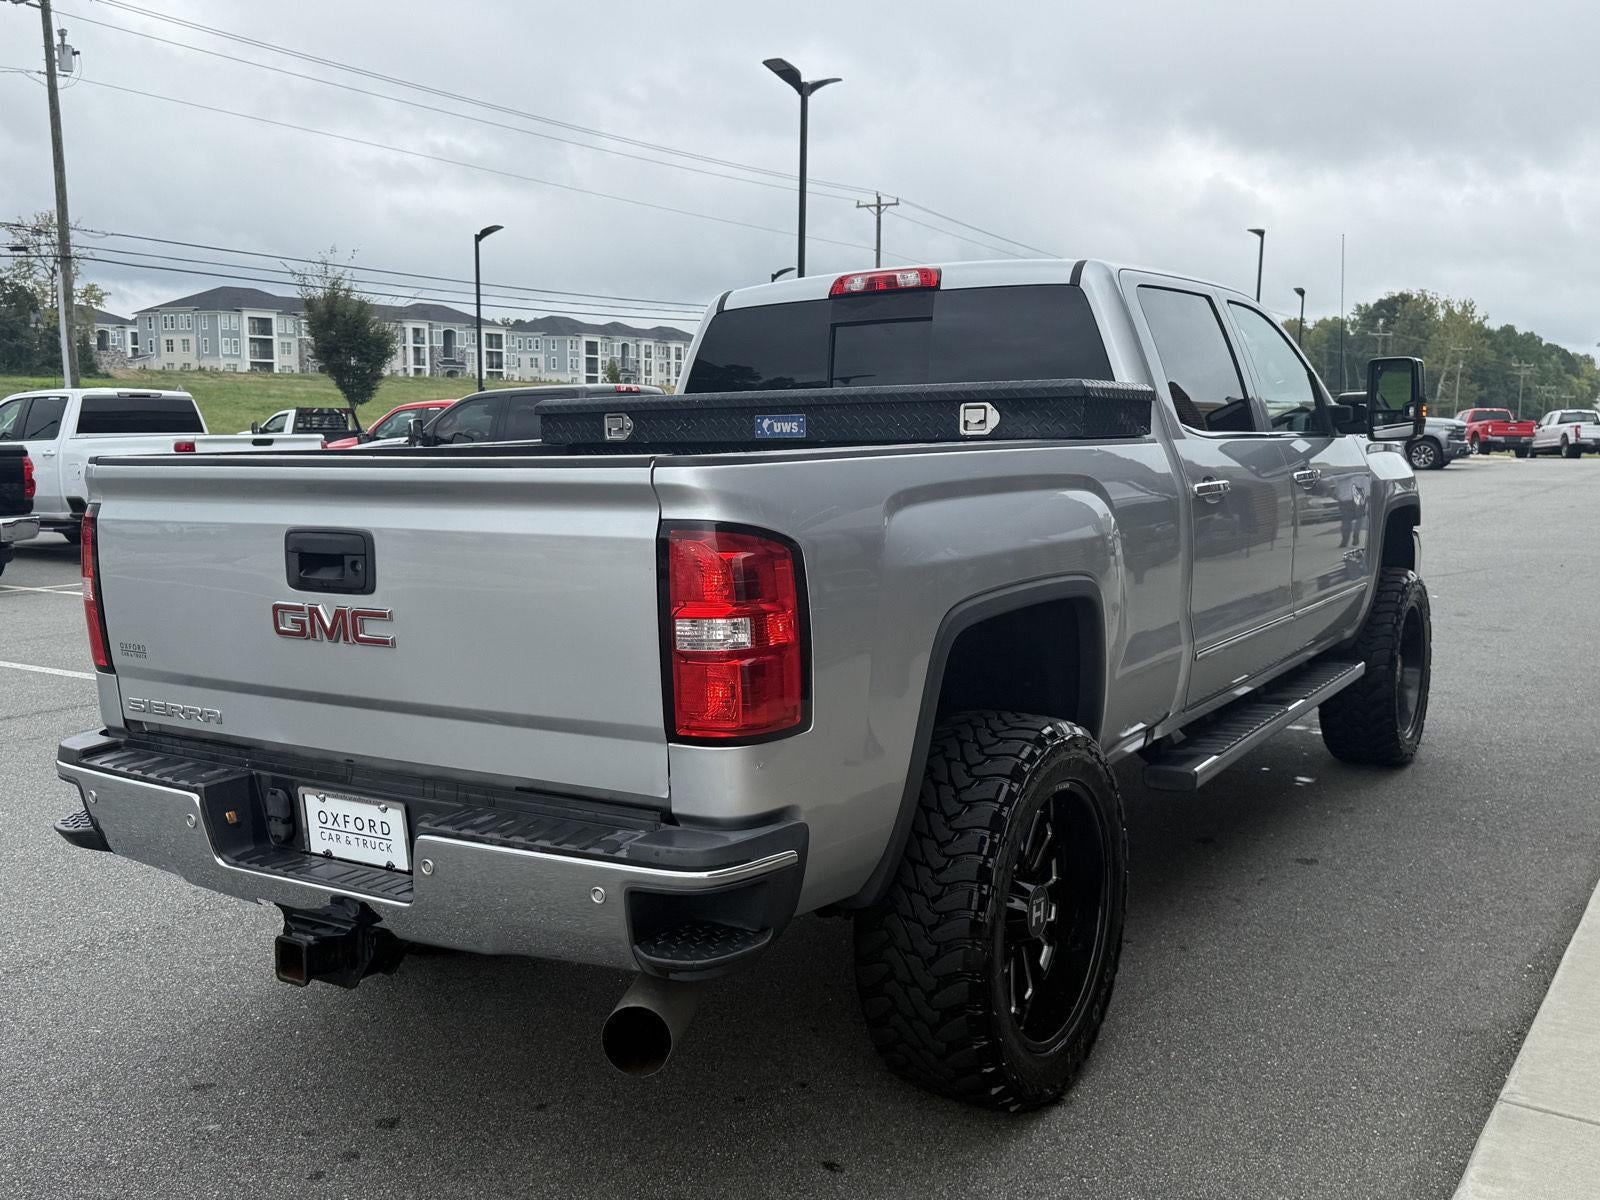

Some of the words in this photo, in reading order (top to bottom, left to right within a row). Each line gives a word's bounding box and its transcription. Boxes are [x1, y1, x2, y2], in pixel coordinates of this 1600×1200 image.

[773, 422, 799, 433] UWS
[272, 600, 396, 648] GMC
[119, 641, 147, 651] OXFORD
[128, 697, 223, 725] SIERRA
[317, 810, 391, 836] OXFORD
[320, 831, 341, 844] CAR
[345, 836, 352, 846] &
[354, 837, 393, 854] TRUCK
